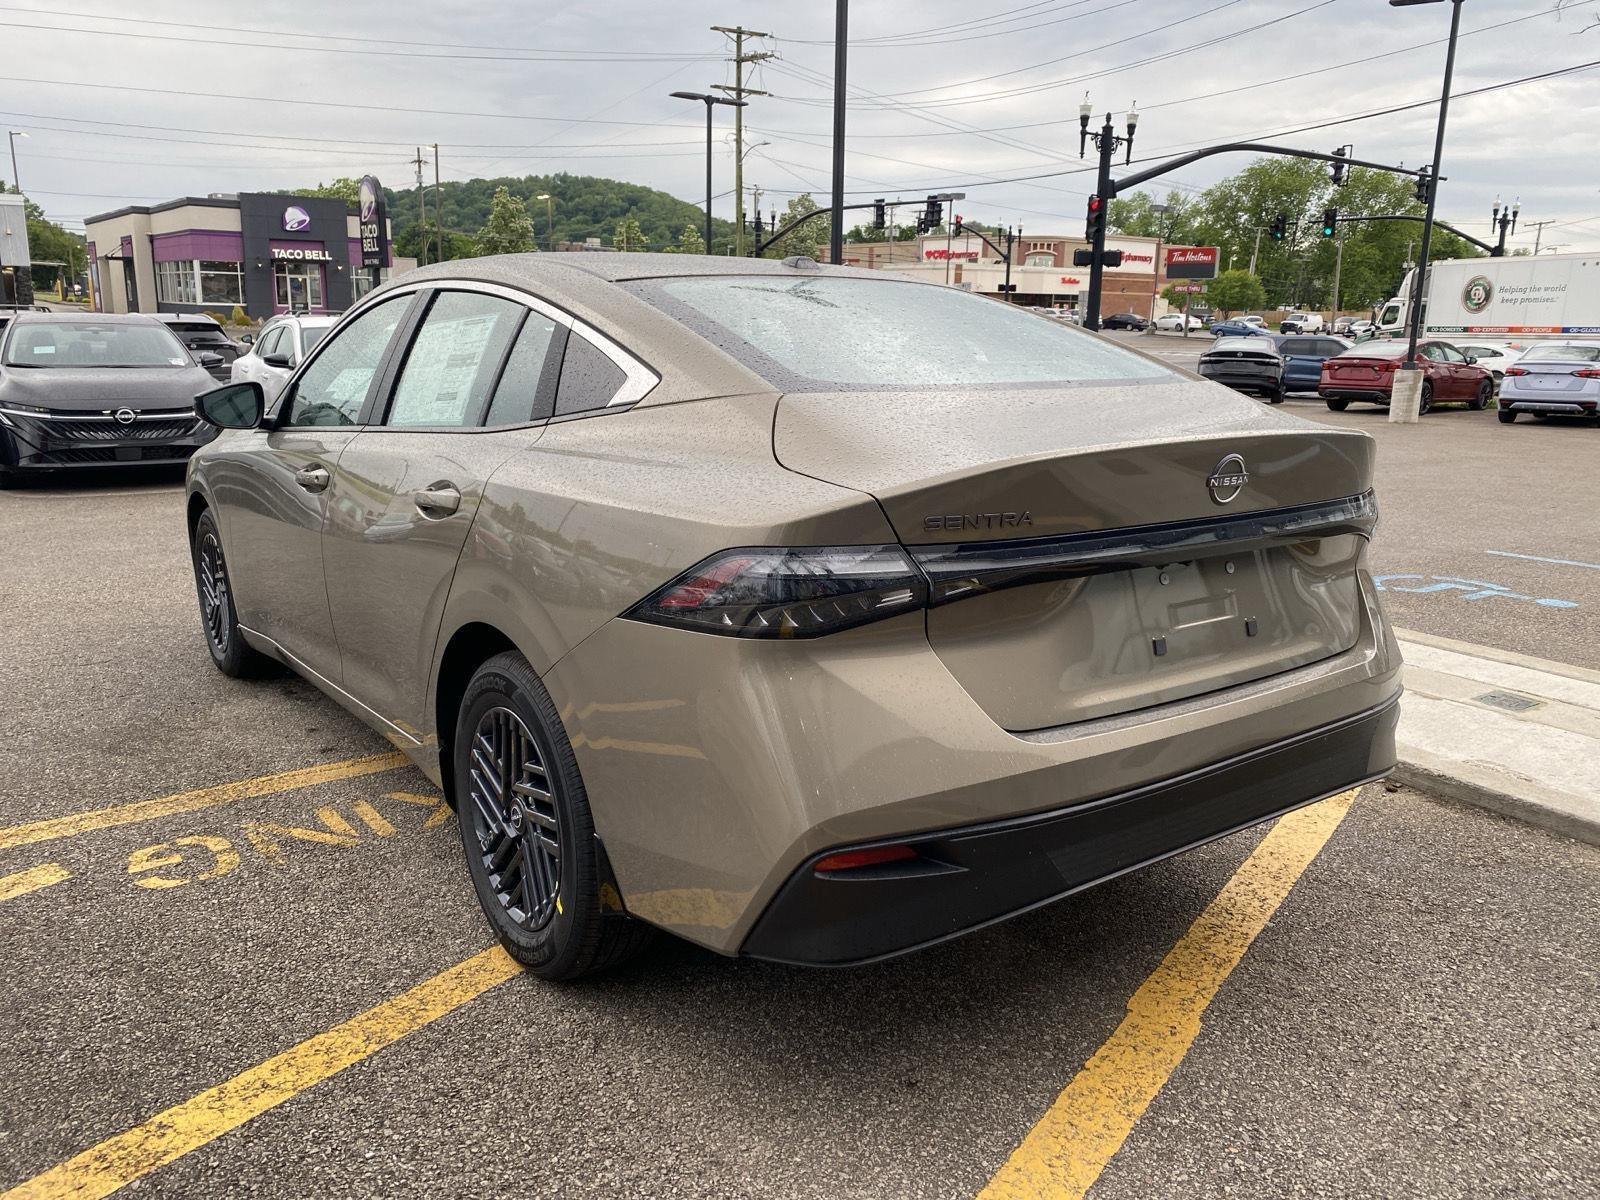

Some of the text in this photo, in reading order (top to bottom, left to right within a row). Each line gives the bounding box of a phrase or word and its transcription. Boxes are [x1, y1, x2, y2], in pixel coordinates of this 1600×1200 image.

[361, 224, 377, 238] TACO
[363, 238, 379, 252] BELL
[272, 249, 332, 260] TACO BELL
[1125, 253, 1153, 264] pharmacy
[1172, 251, 1212, 262] Tim Hortons
[1499, 283, 1568, 294] Helping the world
[1501, 296, 1518, 304] keep
[1210, 475, 1249, 487] NISSAN
[924, 511, 1033, 532] SENTRA
